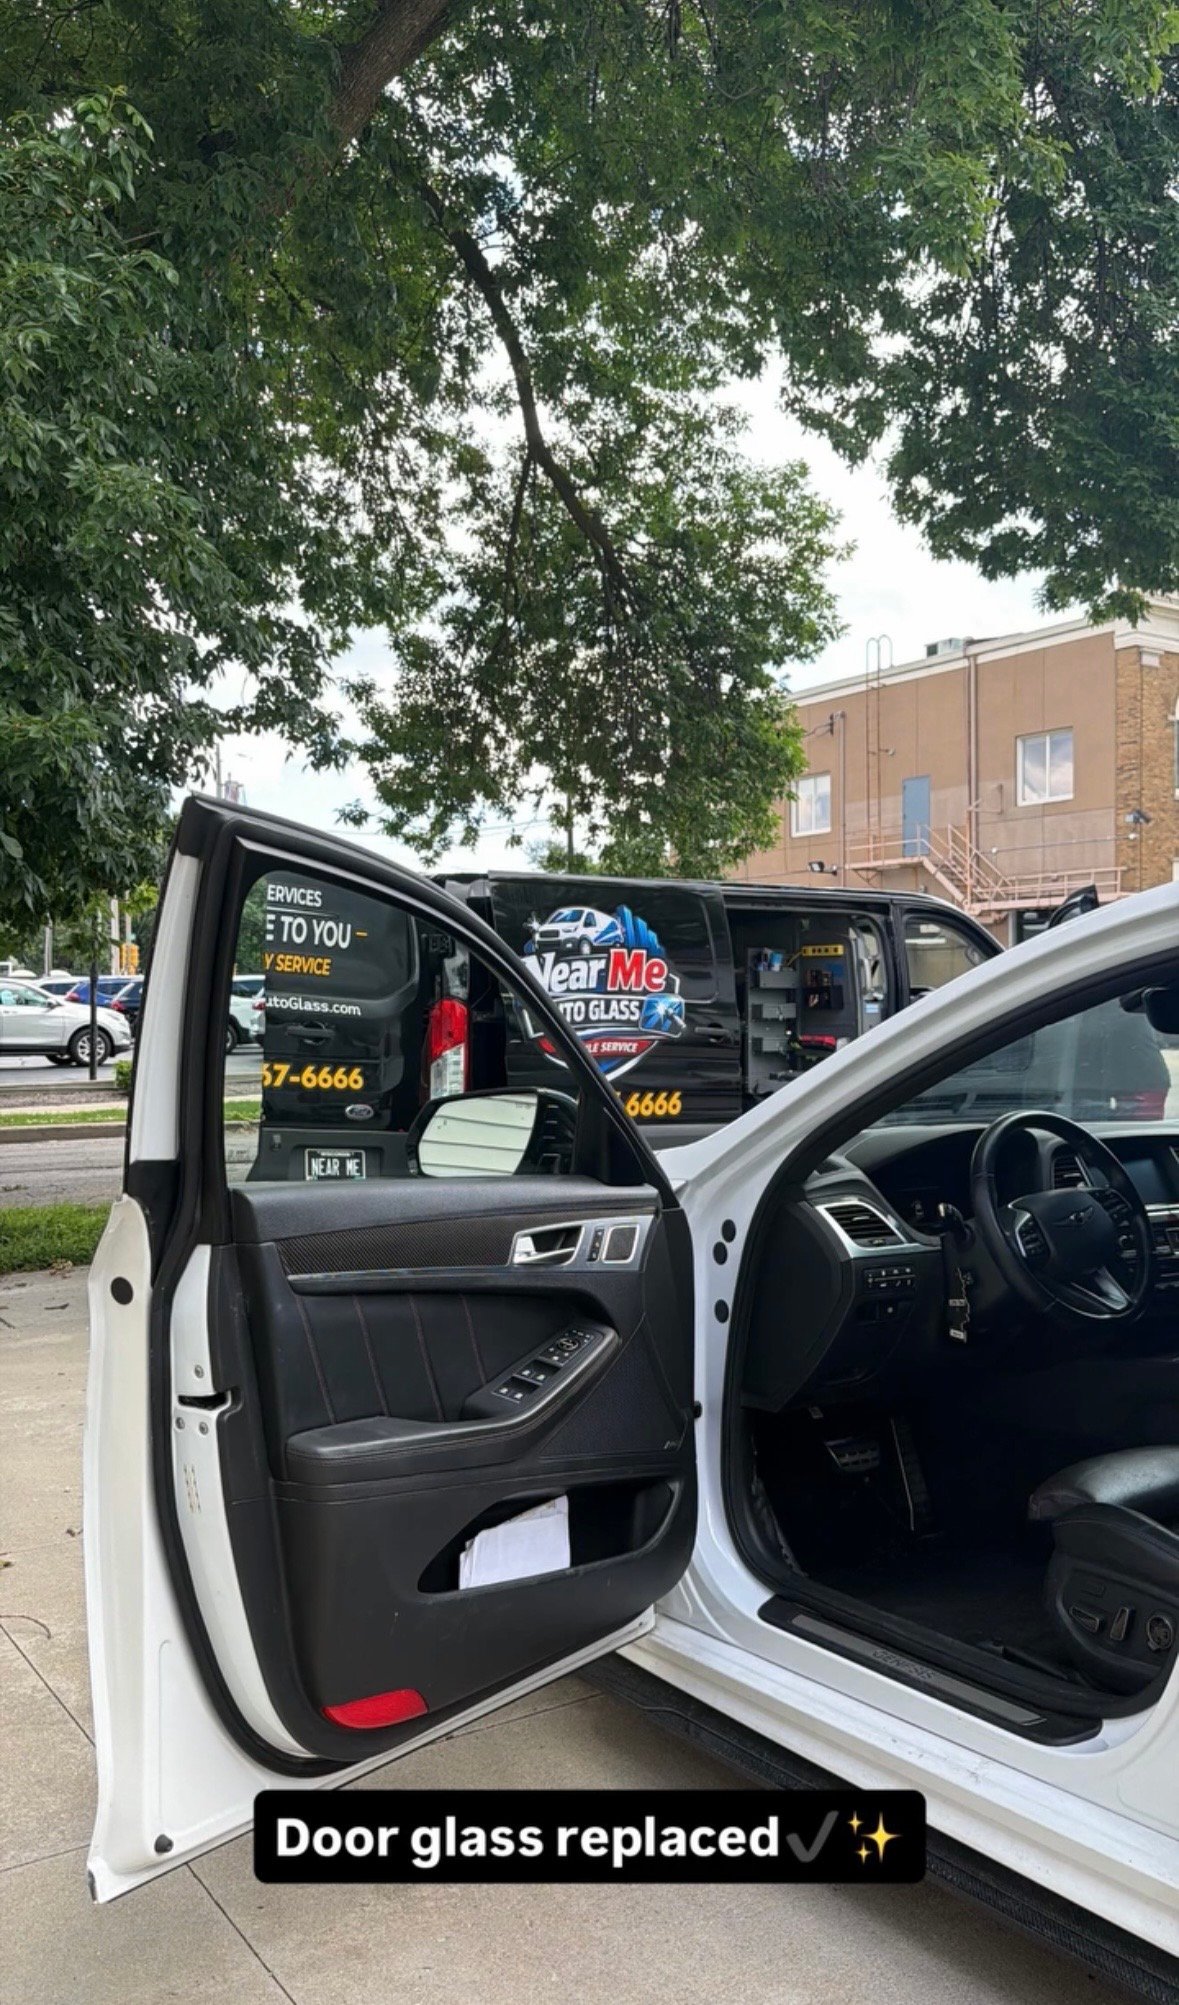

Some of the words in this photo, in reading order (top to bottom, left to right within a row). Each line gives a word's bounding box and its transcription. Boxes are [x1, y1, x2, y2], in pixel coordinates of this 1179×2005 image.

[266, 884, 322, 907] ERVICES
[280, 915, 307, 944] TO
[312, 919, 352, 949] YOU
[275, 954, 332, 976] SERVICE
[521, 951, 606, 993] Near
[607, 948, 668, 992] Me
[559, 1001, 586, 1022] TO
[588, 1000, 640, 1021] GLASS
[600, 1041, 639, 1053] SERVICE
[616, 1091, 682, 1117] 6666
[310, 1158, 340, 1176] NEAR
